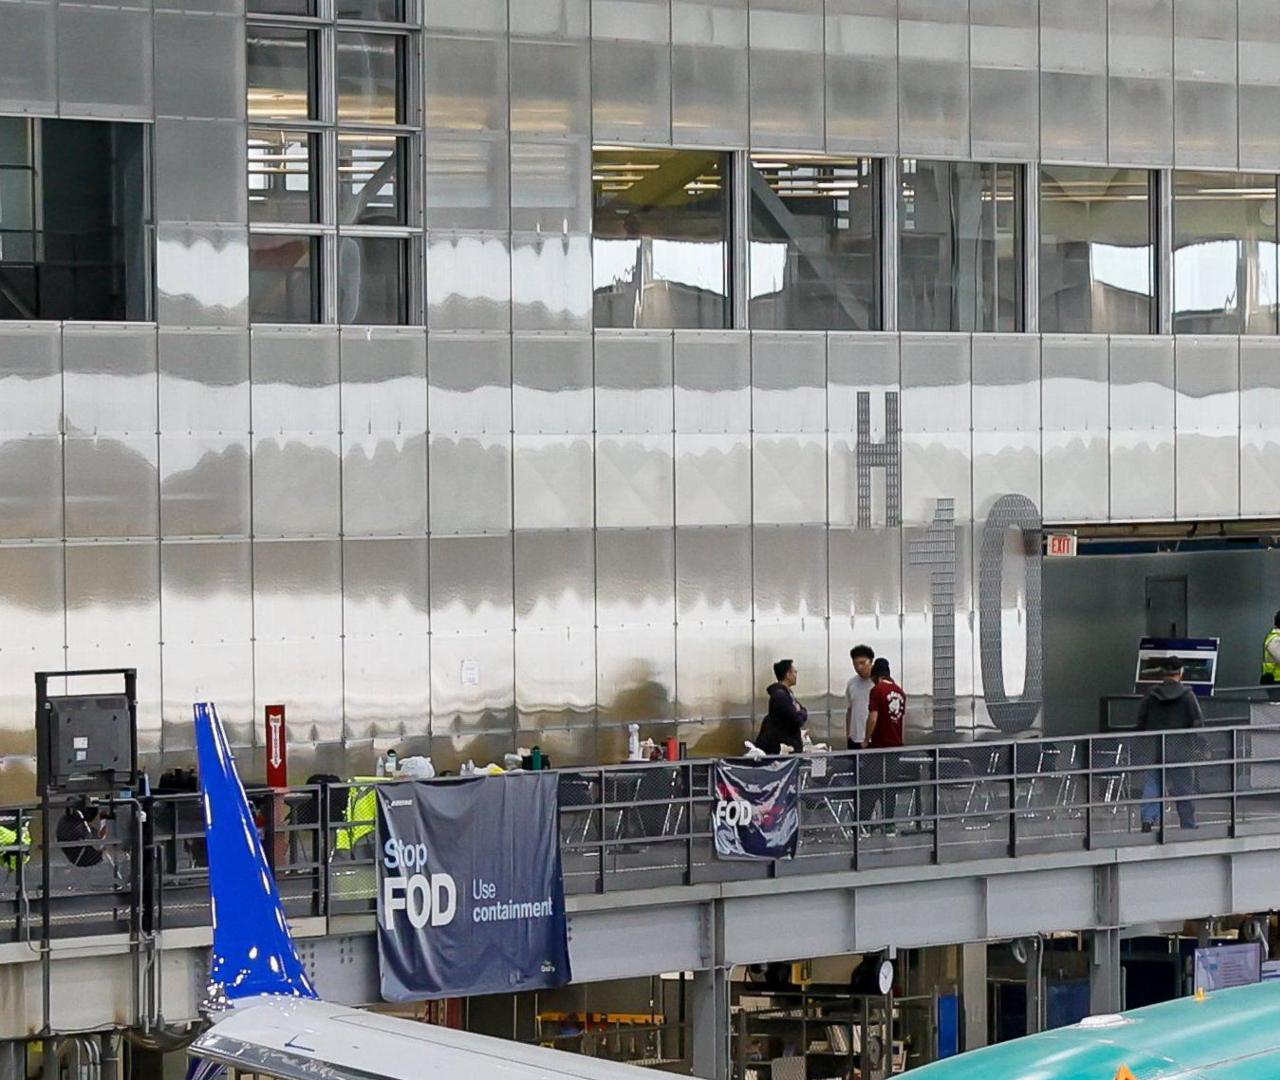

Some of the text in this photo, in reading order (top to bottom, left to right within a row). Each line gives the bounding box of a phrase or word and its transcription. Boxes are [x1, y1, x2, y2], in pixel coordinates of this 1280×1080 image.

[857, 391, 898, 528] H
[1052, 537, 1071, 555] EXIT
[909, 493, 1042, 732] 10
[716, 800, 752, 827] FOD
[384, 838, 427, 872] Stop
[384, 873, 457, 930] FOD
[473, 879, 496, 899] Use
[473, 897, 553, 923] containment
